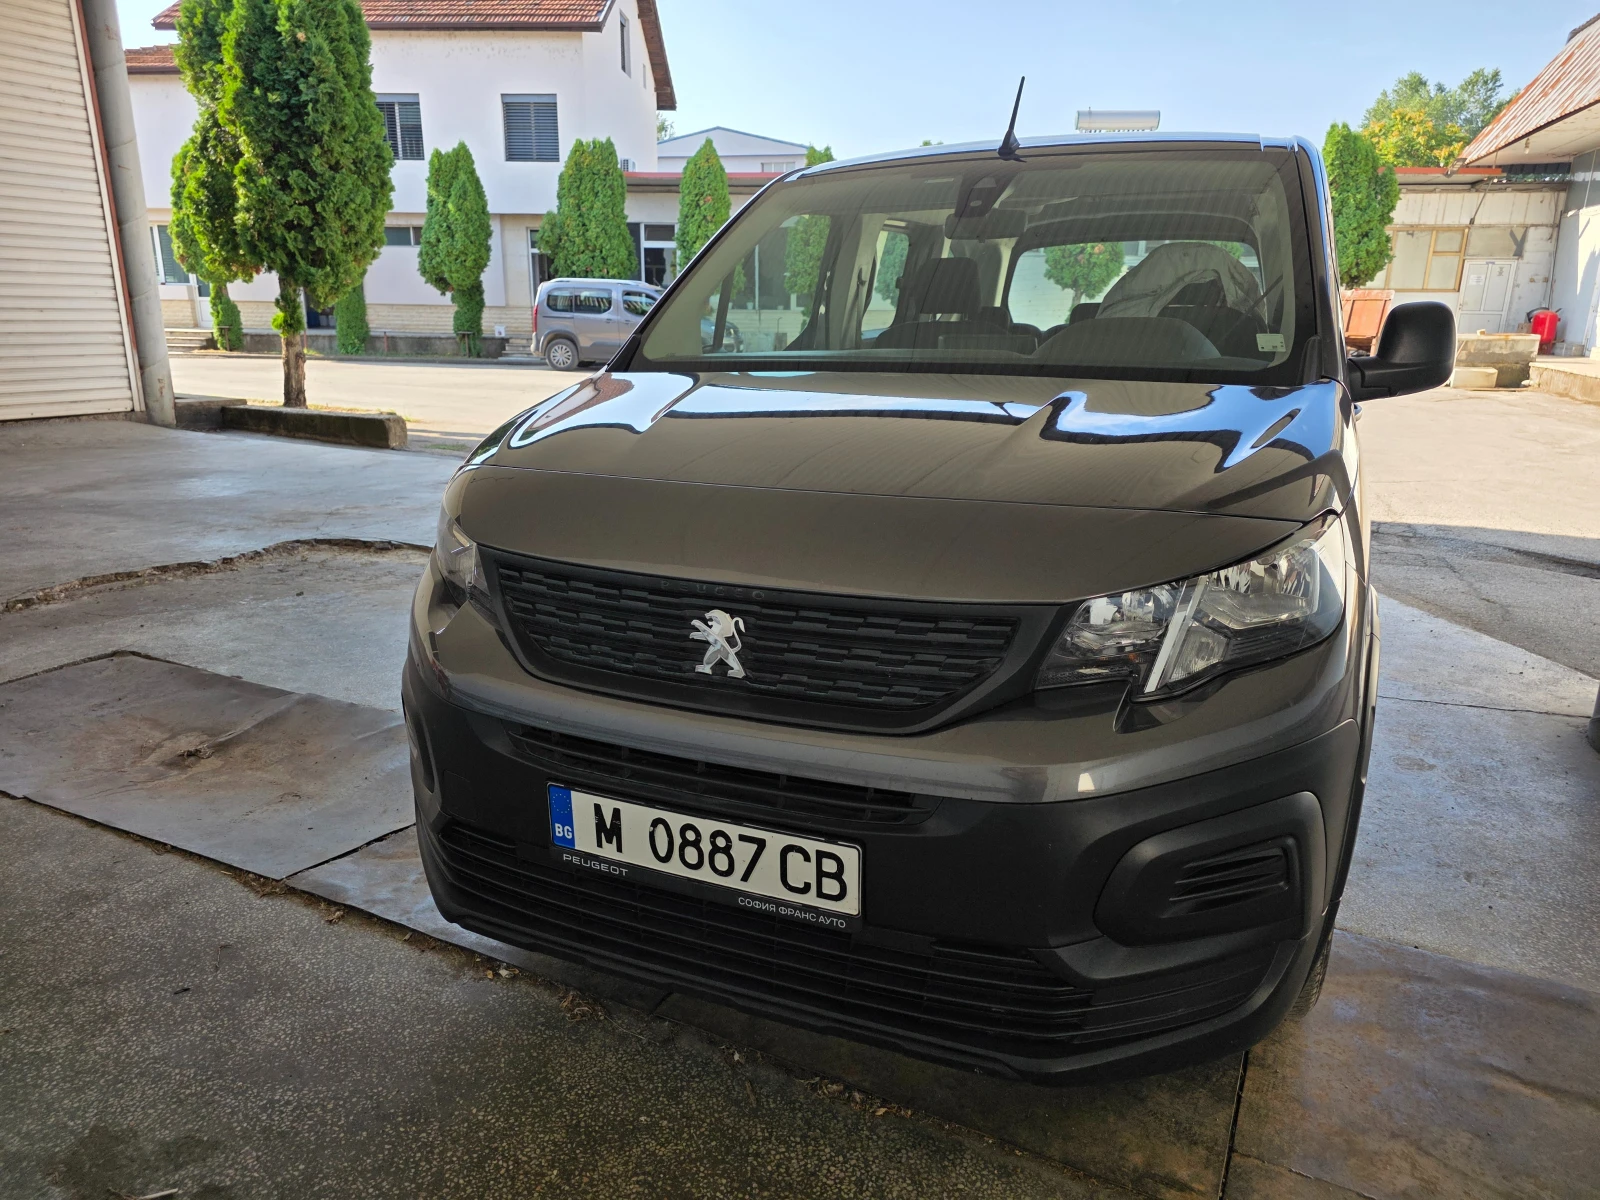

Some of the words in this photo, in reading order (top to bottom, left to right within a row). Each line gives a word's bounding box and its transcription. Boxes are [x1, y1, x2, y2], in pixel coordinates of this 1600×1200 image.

[660, 579, 778, 601] PEUGEO
[554, 823, 573, 839] BG
[593, 802, 624, 854] M
[648, 816, 767, 882] 0887
[779, 843, 848, 902] CB
[562, 853, 629, 876] PEUGEOT
[738, 897, 776, 912] СОФИЯ
[778, 906, 817, 922] ФРАНС
[818, 915, 846, 928] АУТО
